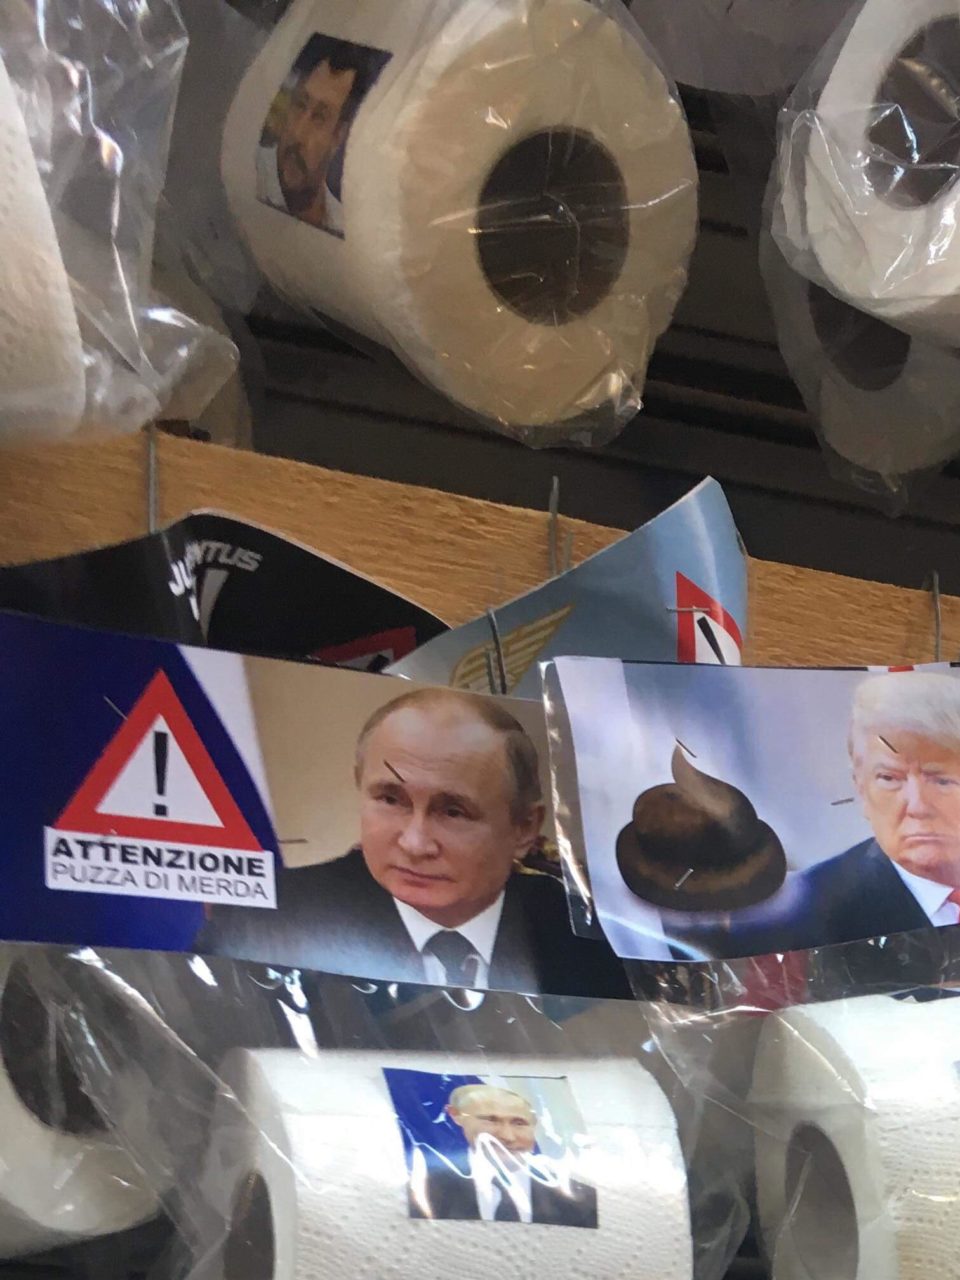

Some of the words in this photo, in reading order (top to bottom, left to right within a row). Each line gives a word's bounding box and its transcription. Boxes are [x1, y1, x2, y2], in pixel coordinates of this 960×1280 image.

[52, 837, 267, 878] ATTENZIONE
[52, 861, 138, 888] PUZZA
[144, 870, 170, 892] DI
[178, 874, 270, 901] MERDA
